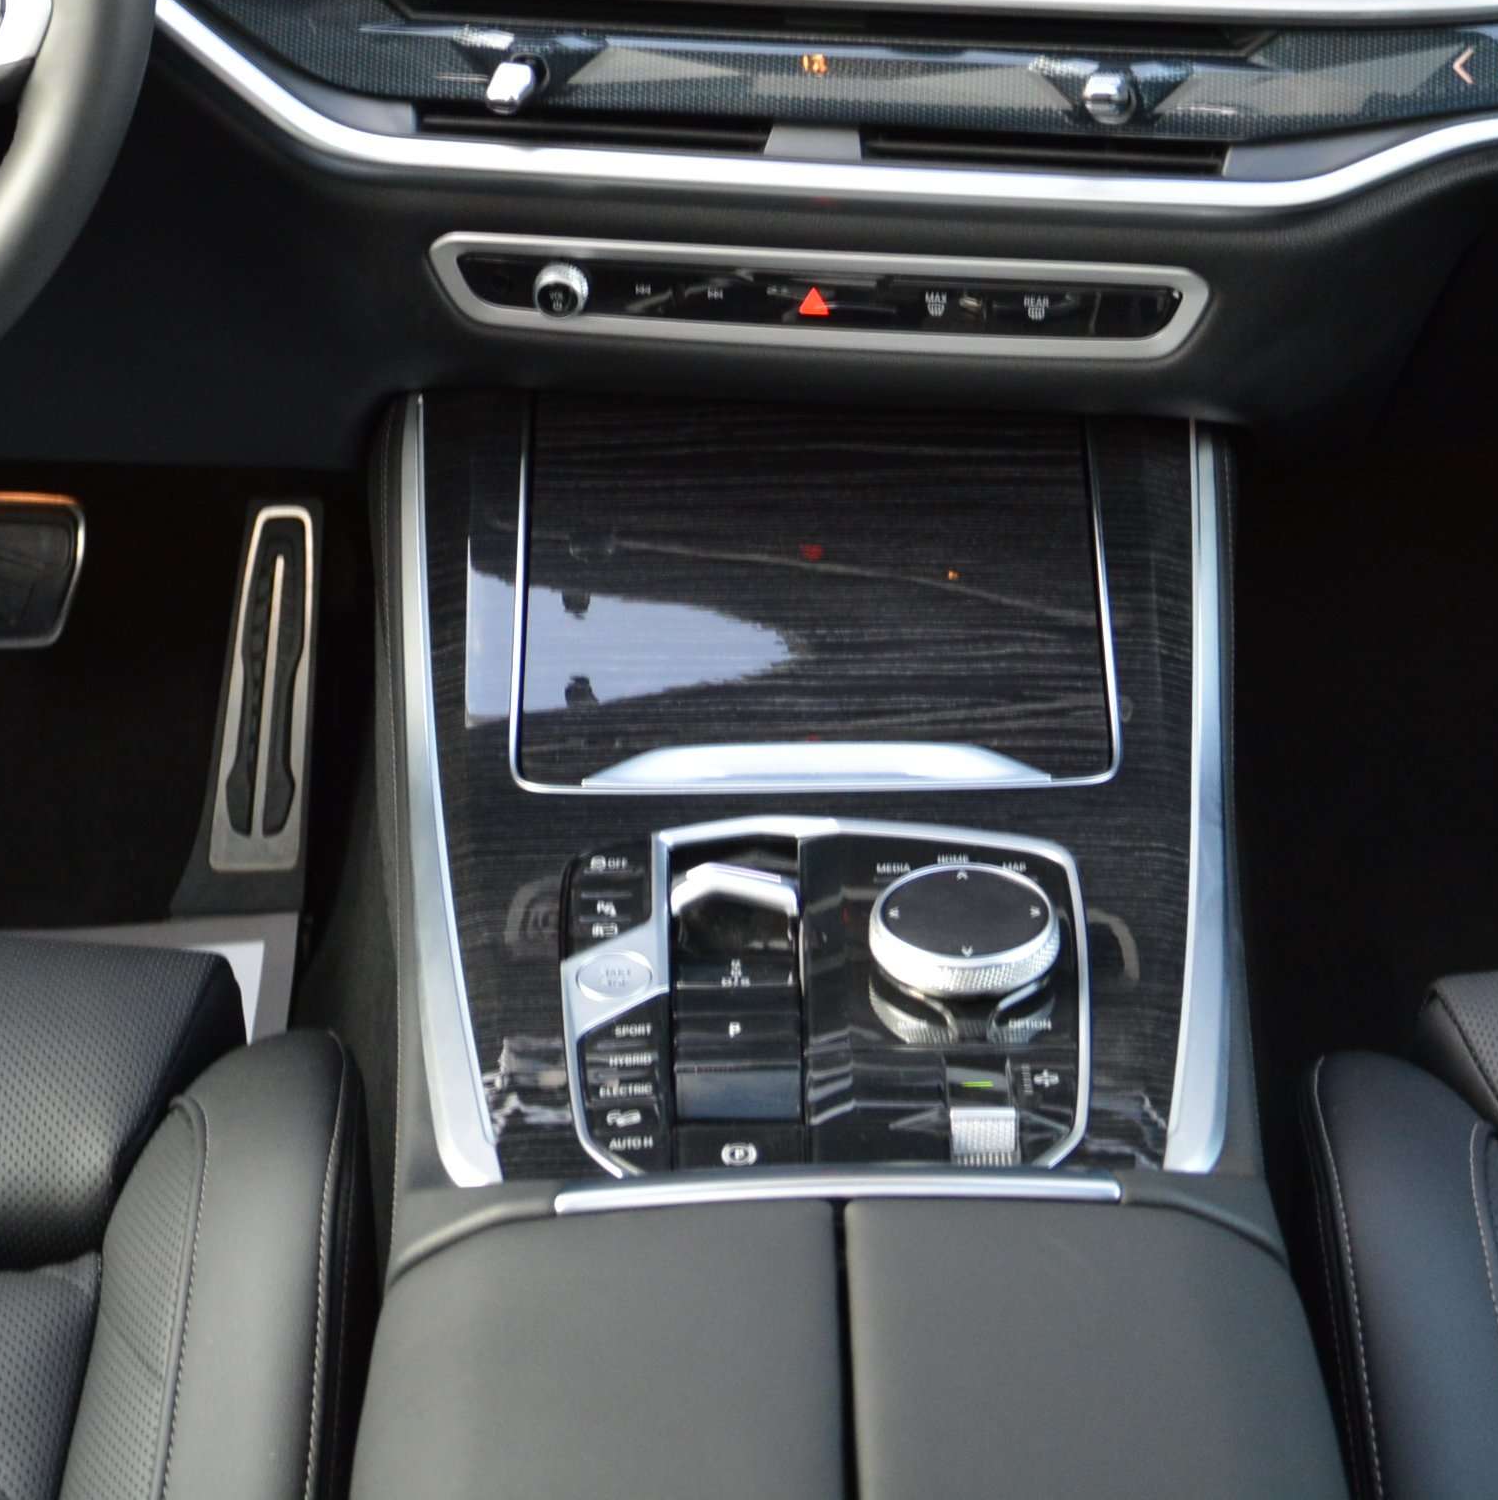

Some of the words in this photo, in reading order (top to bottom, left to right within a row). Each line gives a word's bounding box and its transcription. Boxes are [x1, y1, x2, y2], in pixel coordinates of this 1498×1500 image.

[925, 292, 947, 305] MAX
[1023, 295, 1050, 309] REAR
[607, 857, 629, 870] OFF
[876, 862, 912, 875] MEDIA
[614, 1023, 652, 1038] SPORT
[729, 1021, 742, 1038] P
[1008, 1018, 1053, 1030] OPTION
[608, 1052, 652, 1068] HYBRID
[599, 1083, 653, 1099] ELECTRIC
[608, 1137, 641, 1151] AUTO
[643, 1135, 654, 1149] H
